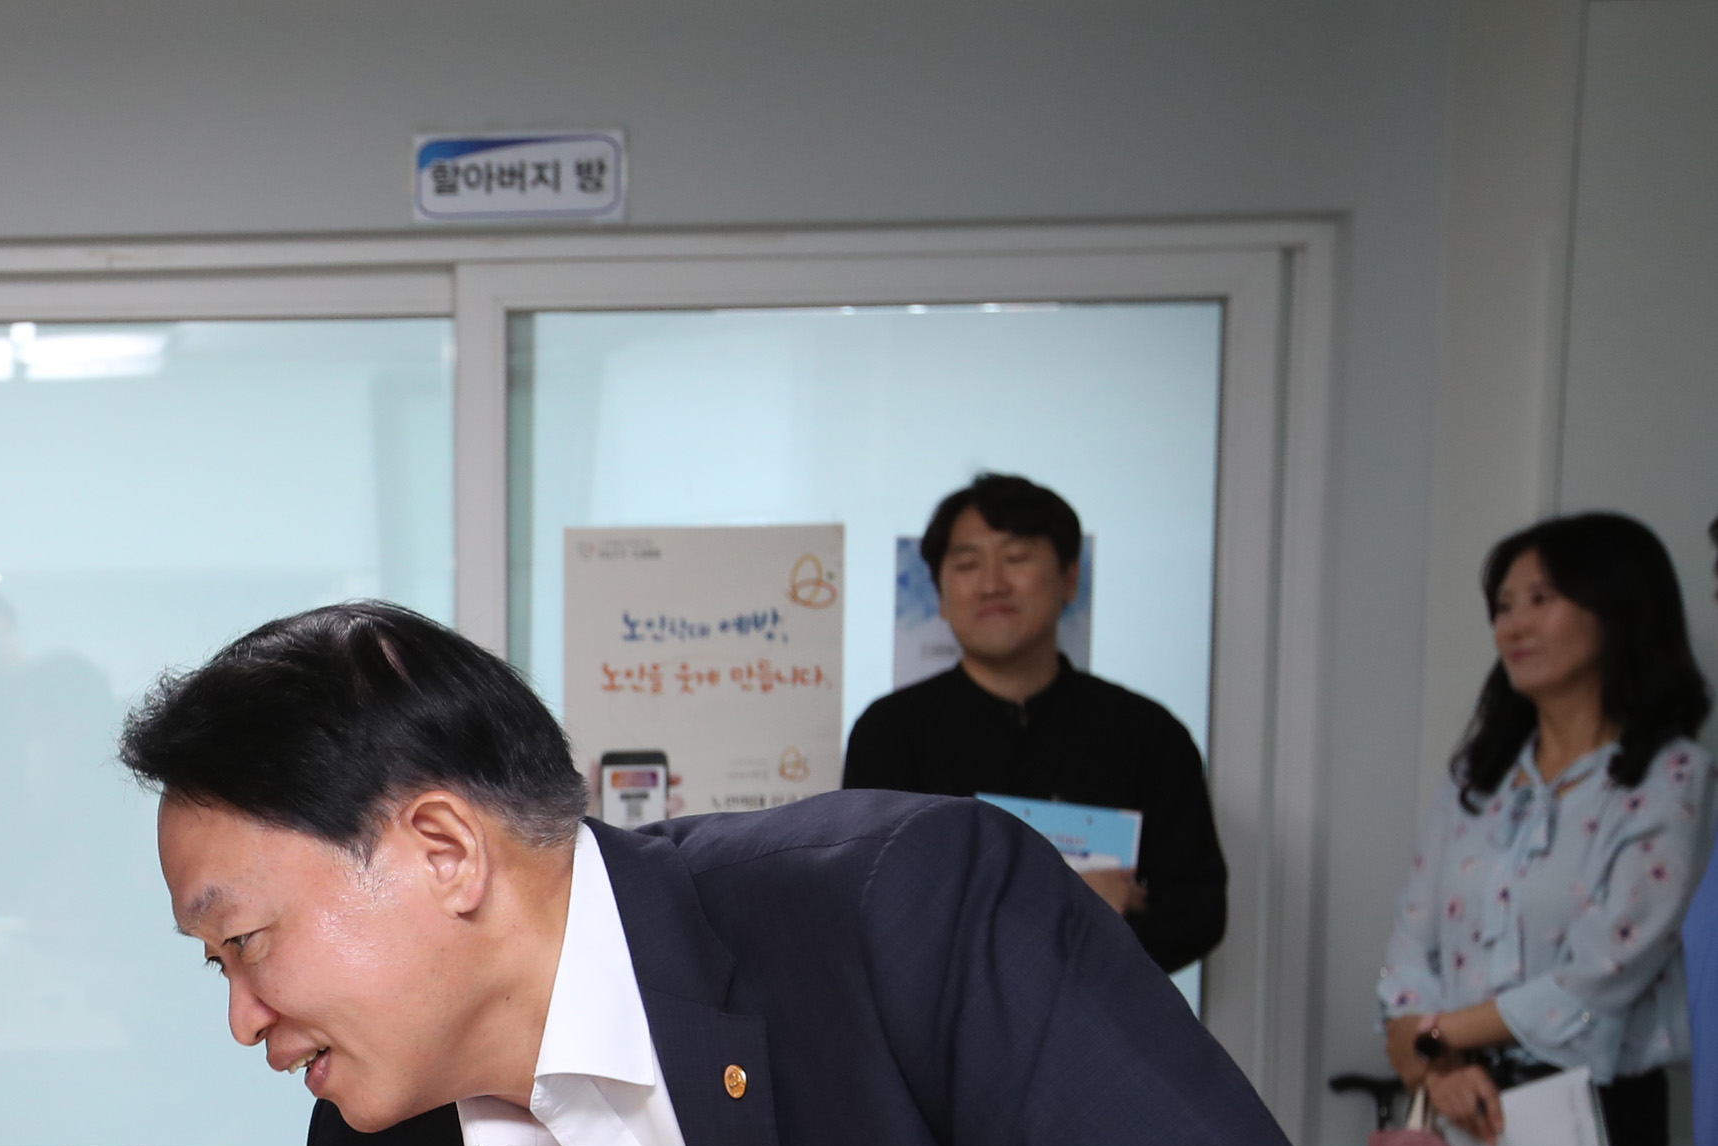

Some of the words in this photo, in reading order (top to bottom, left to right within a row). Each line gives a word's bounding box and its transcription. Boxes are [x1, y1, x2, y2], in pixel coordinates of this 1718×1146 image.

[431, 160, 562, 196] 할아버지
[575, 158, 607, 194] 방
[601, 660, 664, 695] 노인을
